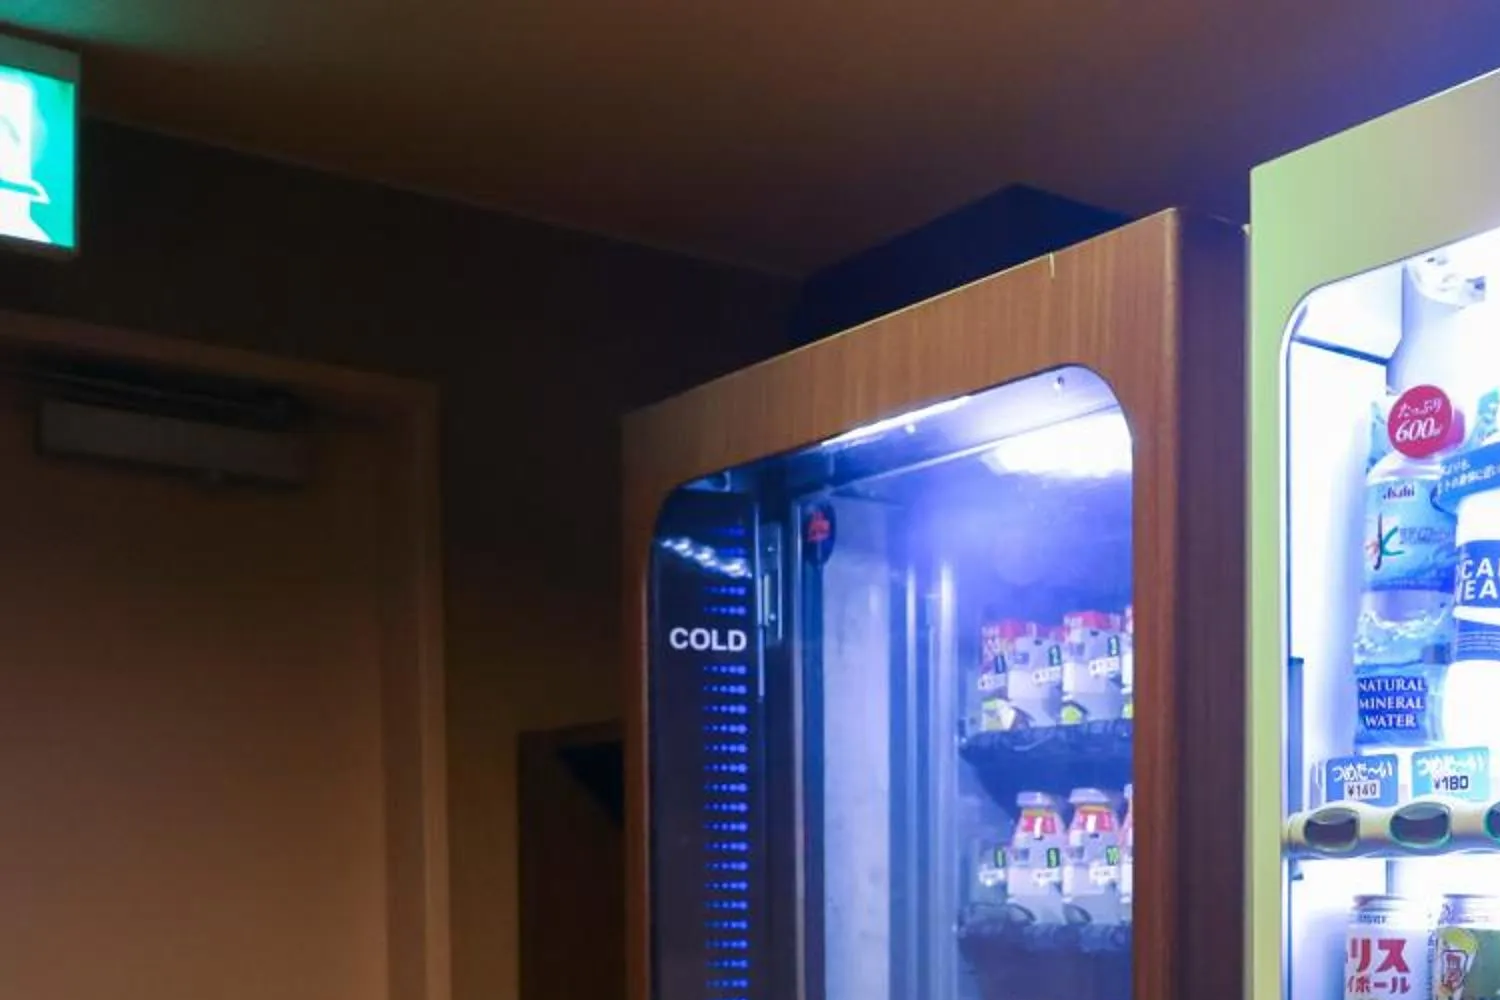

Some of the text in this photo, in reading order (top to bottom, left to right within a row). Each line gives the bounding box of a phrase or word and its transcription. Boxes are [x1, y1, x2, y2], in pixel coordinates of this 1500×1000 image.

[669, 626, 747, 653] COLD
[1359, 676, 1427, 694] NATURAL
[1359, 696, 1425, 710] MINERAL
[1364, 714, 1417, 729] WATER
